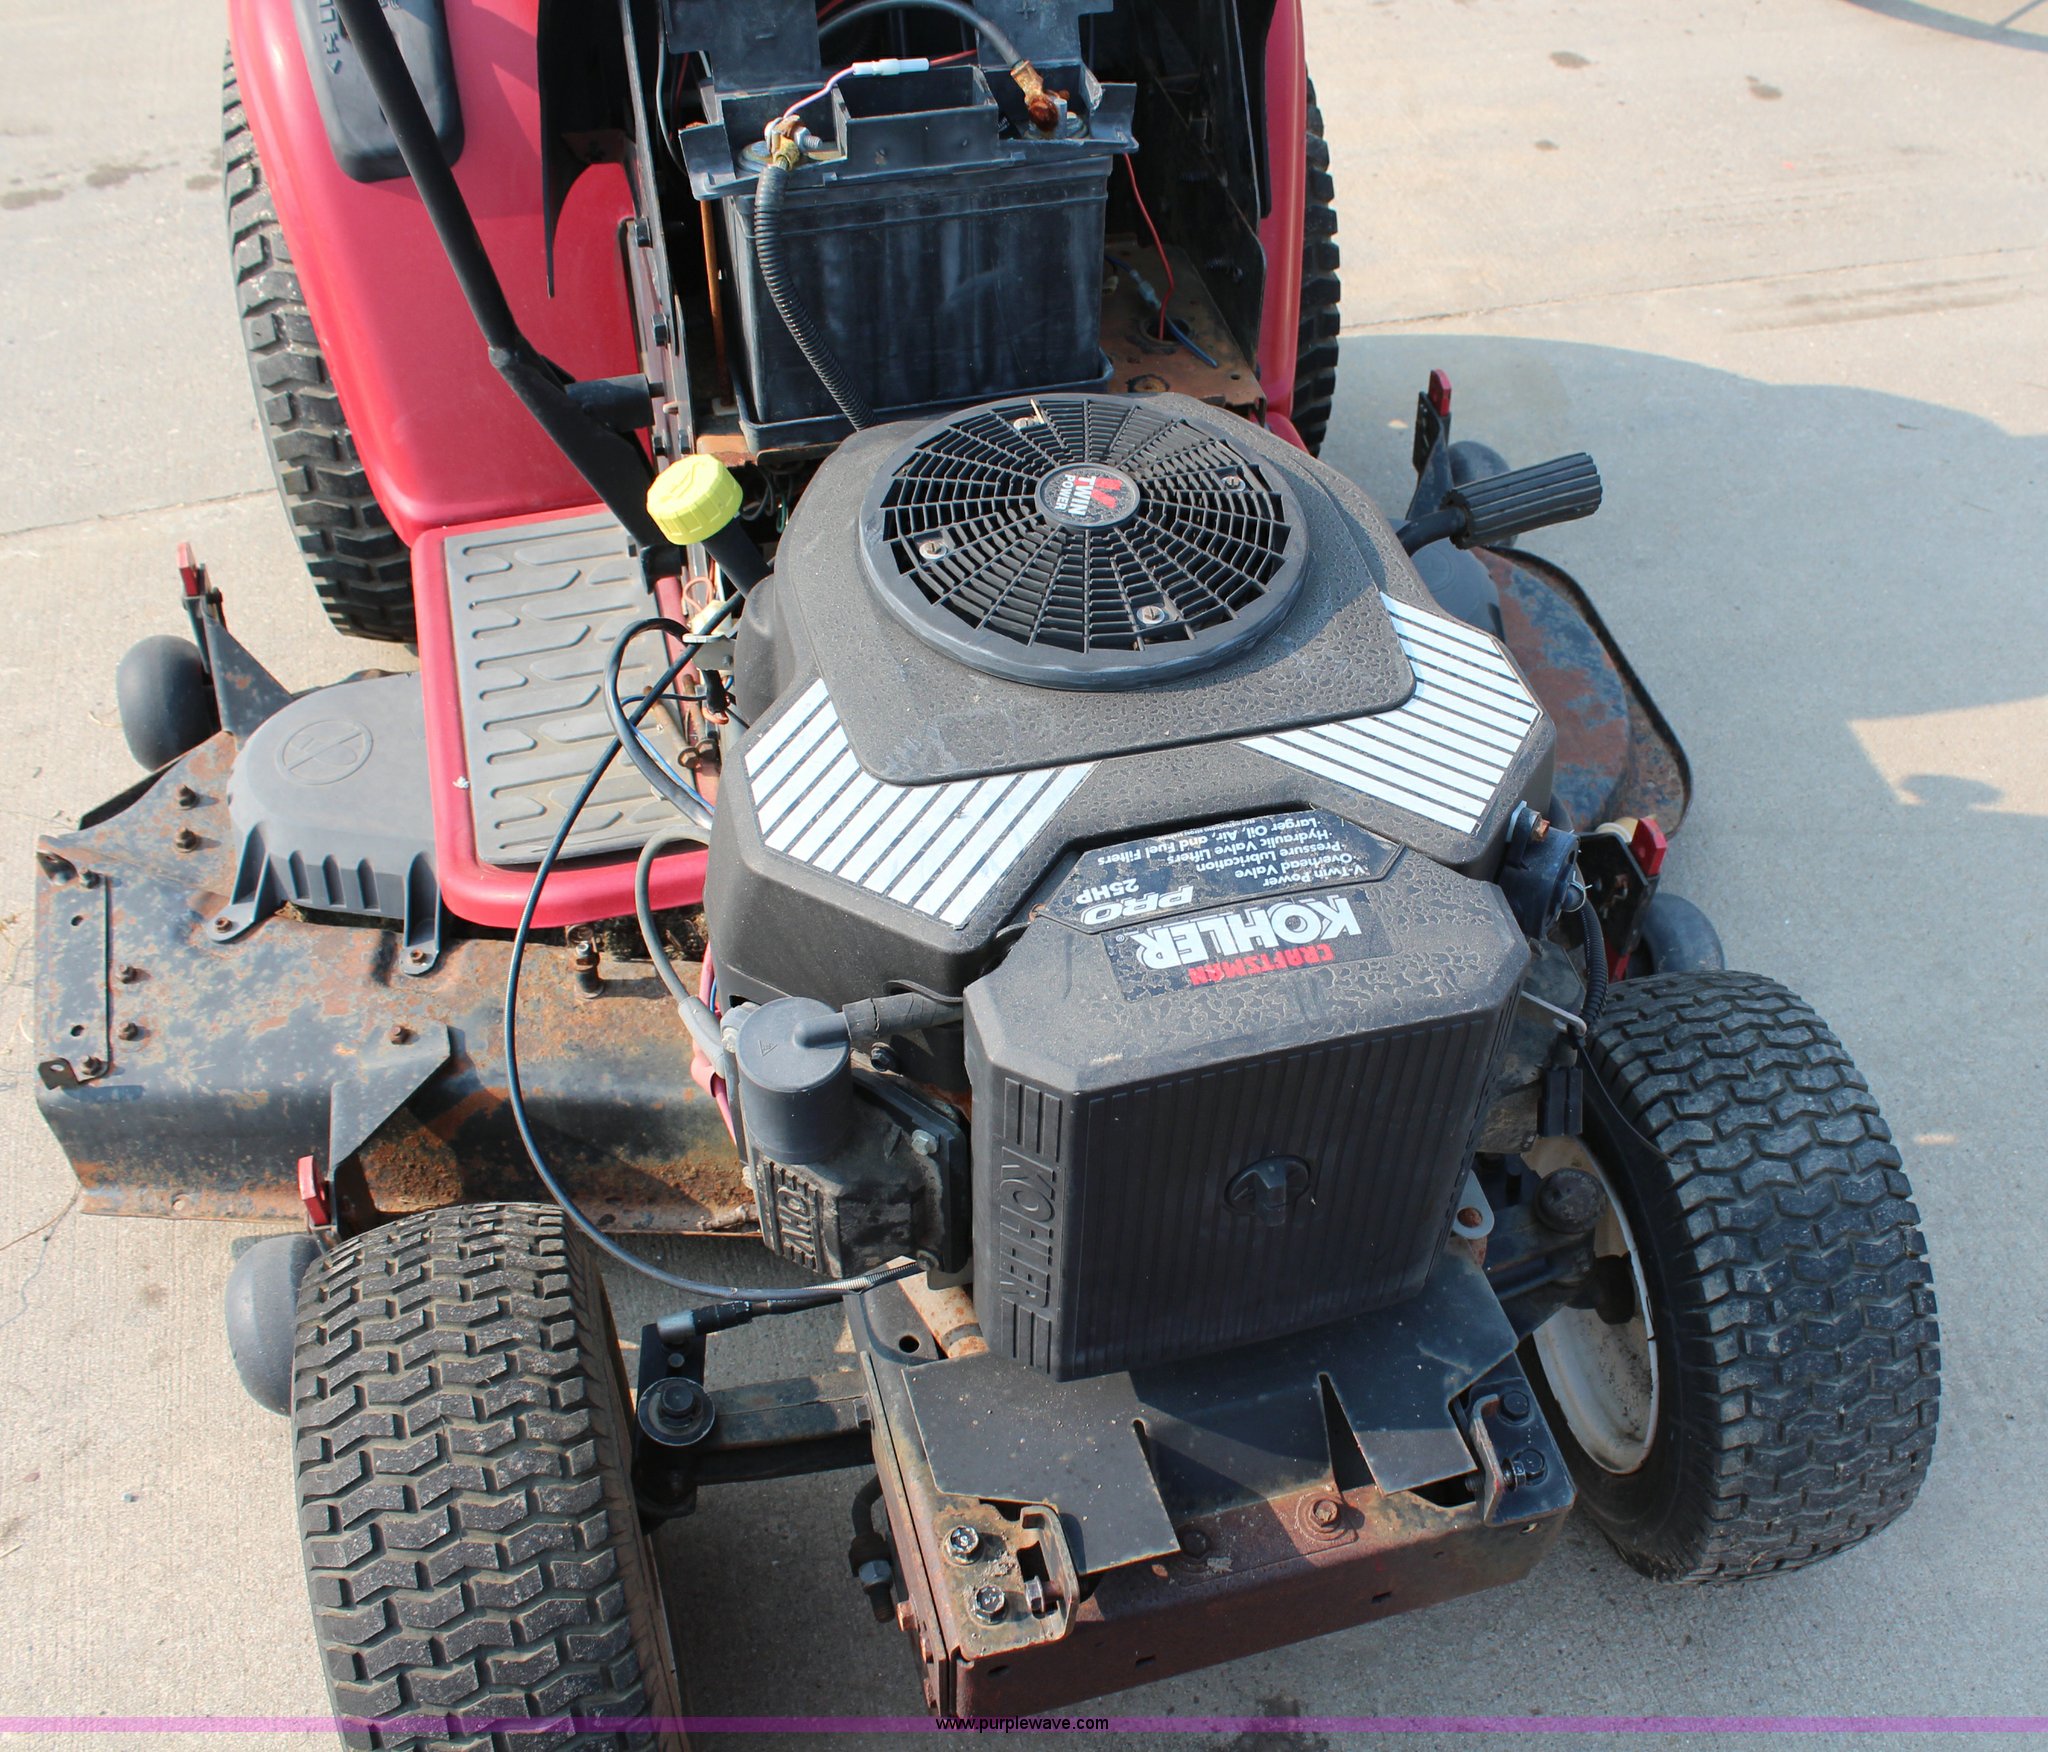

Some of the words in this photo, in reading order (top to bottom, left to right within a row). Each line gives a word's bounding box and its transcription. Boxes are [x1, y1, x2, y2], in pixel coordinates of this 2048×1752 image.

[1055, 474, 1075, 510] POWER
[1068, 477, 1096, 515] TWIN
[1241, 824, 1267, 839] Oil,
[1268, 816, 1317, 833] Larger
[1179, 833, 1208, 847] and
[1212, 826, 1237, 843] Air,
[1261, 826, 1328, 848] Hydraulic
[1098, 848, 1141, 865] Filters
[1145, 840, 1176, 855] Fuel
[1215, 840, 1256, 856] Valve
[1280, 841, 1340, 857] Pressure
[1168, 849, 1211, 865] Lifters
[1197, 850, 1276, 873] Lubrication
[1281, 852, 1352, 872] Overhead
[1235, 864, 1276, 880] Valve
[1263, 869, 1311, 888] Power
[1313, 862, 1364, 880] V-Twin
[1076, 878, 1139, 904] 25HP
[1081, 885, 1193, 925] PRO
[1132, 894, 1361, 969] KOHLER
[1187, 943, 1335, 986] CRAFTSMAN
[1000, 1146, 1057, 1308] KOHLER
